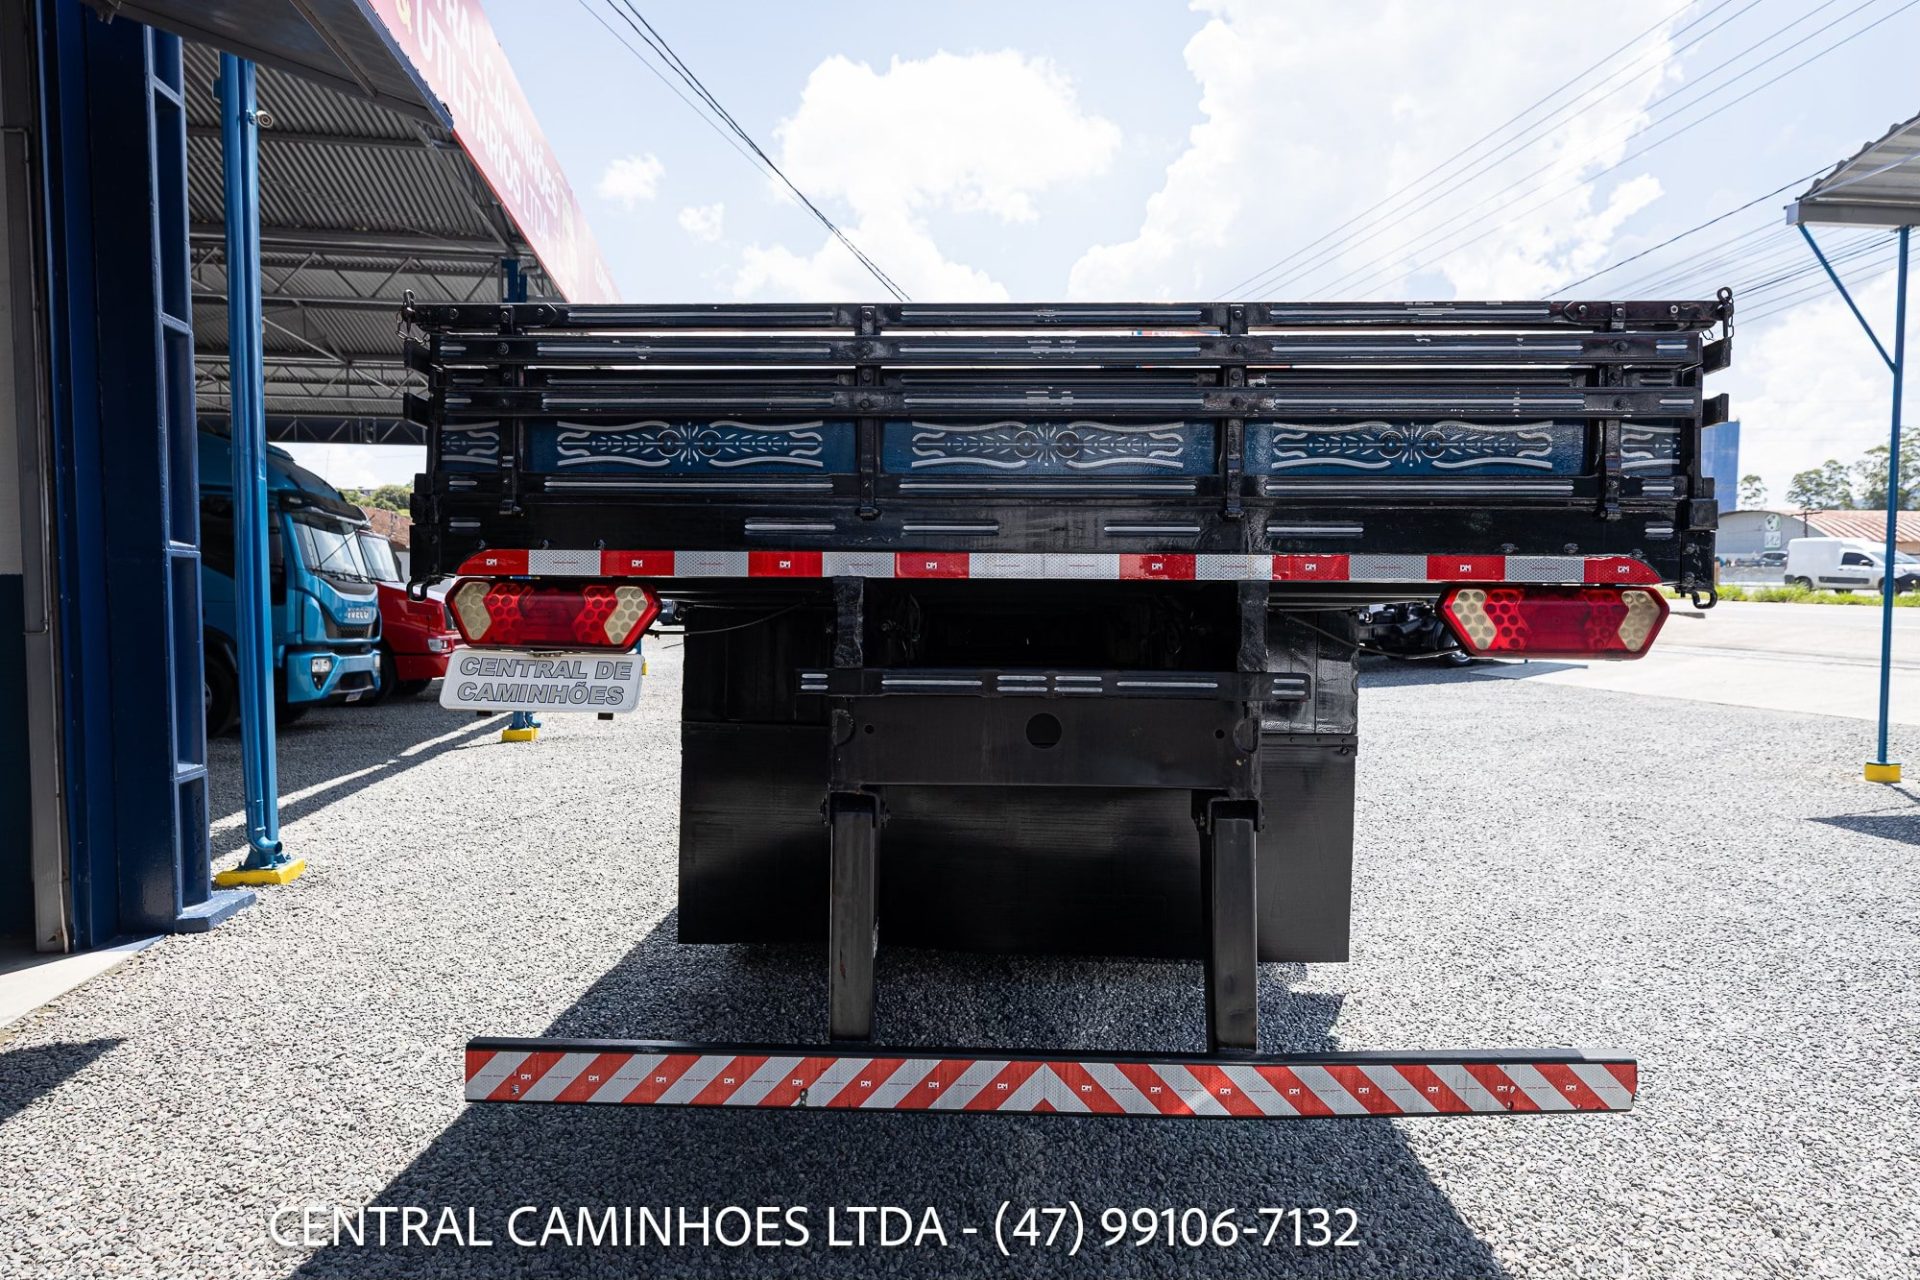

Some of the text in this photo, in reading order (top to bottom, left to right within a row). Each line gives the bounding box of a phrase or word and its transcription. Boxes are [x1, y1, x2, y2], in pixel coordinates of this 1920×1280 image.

[417, 0, 549, 241] UTILITÁRIOS LTDA
[483, 52, 558, 217] CAMINHÕES
[457, 681, 624, 705] CAMINHÕES
[460, 656, 632, 680] CENTRAL DE
